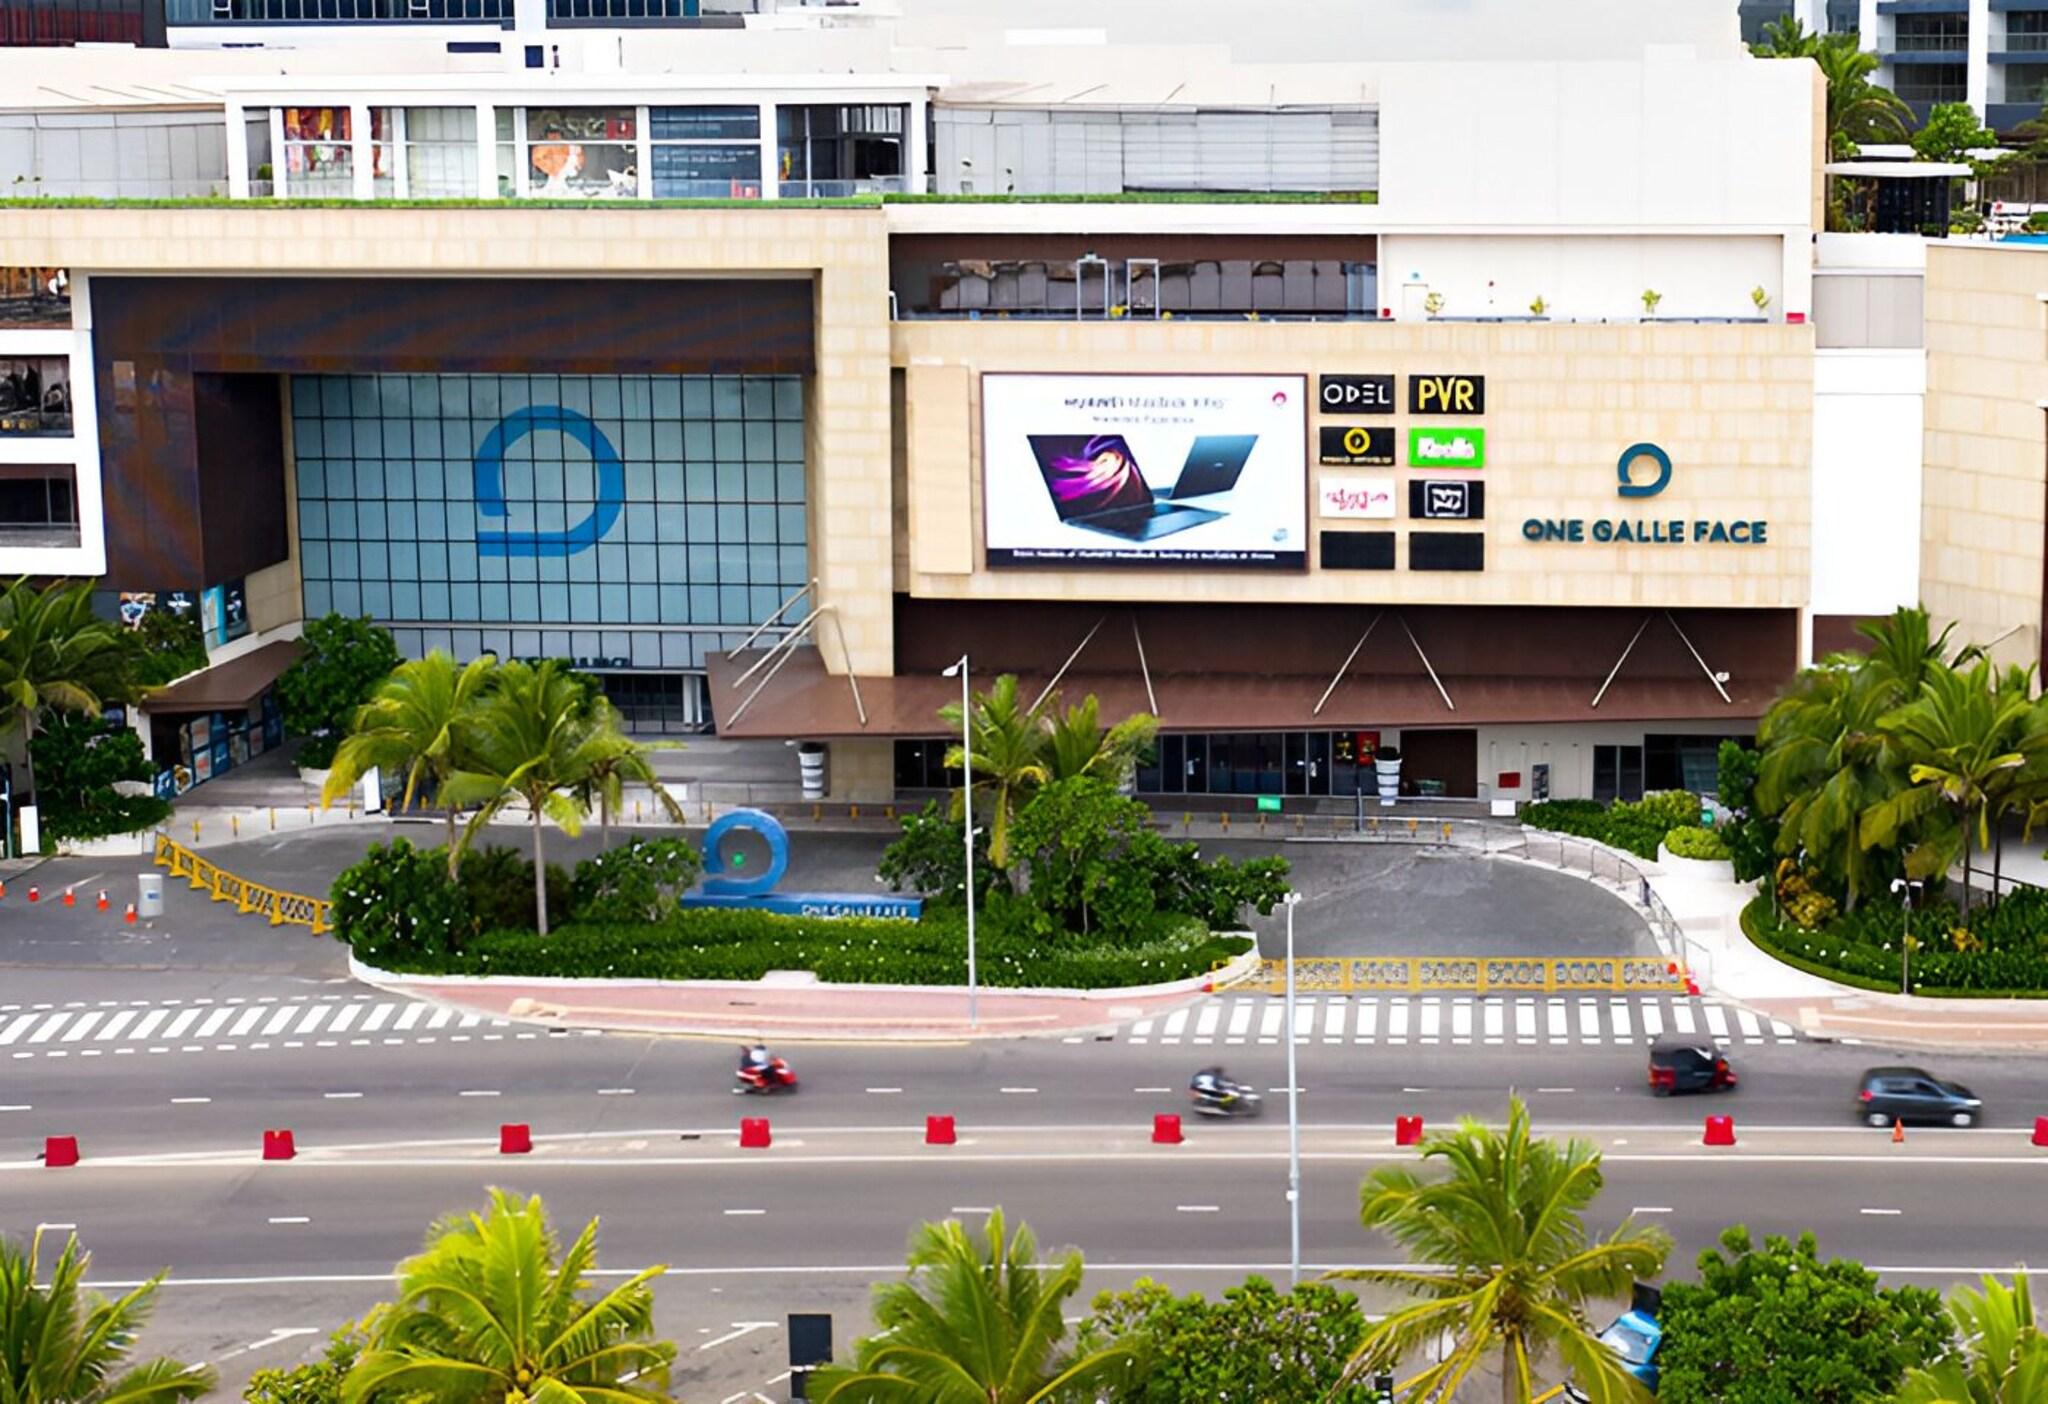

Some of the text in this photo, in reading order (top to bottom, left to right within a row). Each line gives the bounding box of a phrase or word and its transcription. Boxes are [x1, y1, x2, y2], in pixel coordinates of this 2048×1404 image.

[1323, 383, 1390, 404] ODEL
[1418, 377, 1474, 412] PVR
[1522, 518, 1768, 544] ONE GALLE FACE
